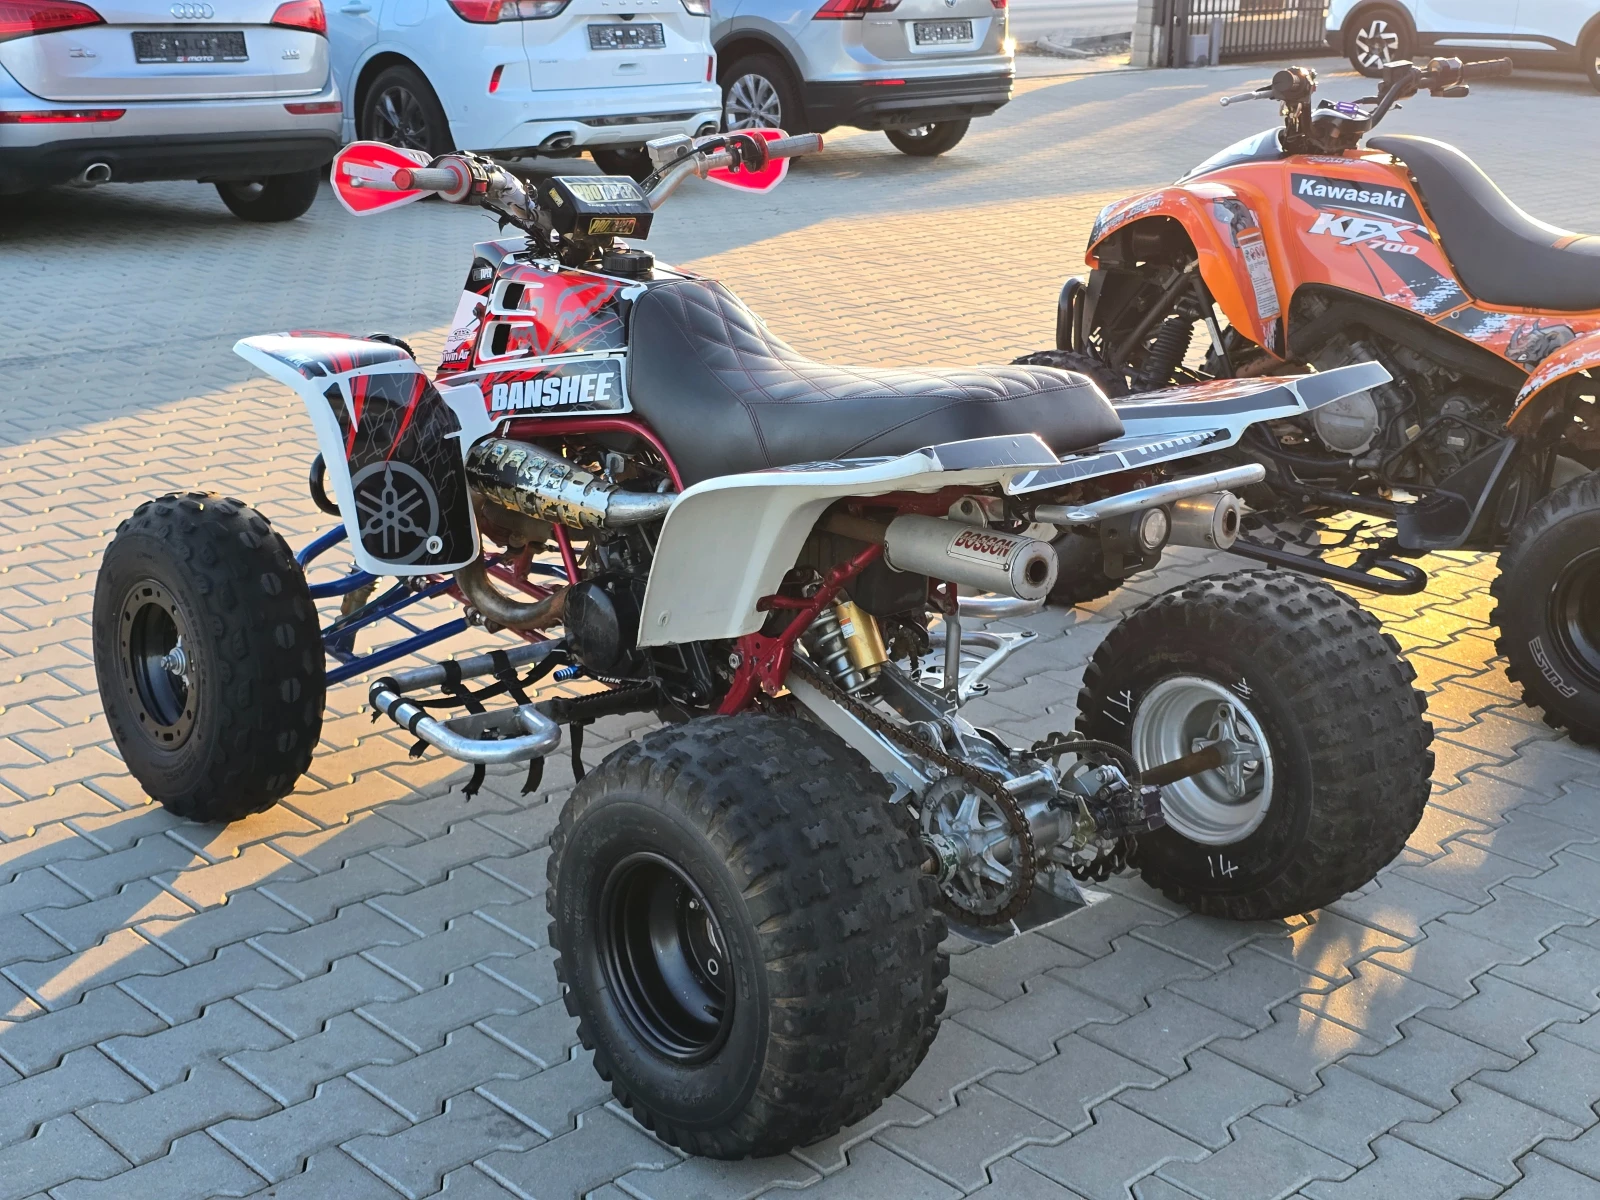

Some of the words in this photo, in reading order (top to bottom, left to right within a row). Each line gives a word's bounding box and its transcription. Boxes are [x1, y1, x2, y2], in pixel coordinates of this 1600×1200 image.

[1299, 178, 1406, 209] Kawasaki
[1308, 212, 1417, 246] KFX
[1367, 240, 1420, 255] 700
[491, 372, 615, 412] BANSHEE
[954, 530, 1018, 558] BOSSON
[1528, 636, 1579, 699] PULSE
[1207, 853, 1239, 879] 14
